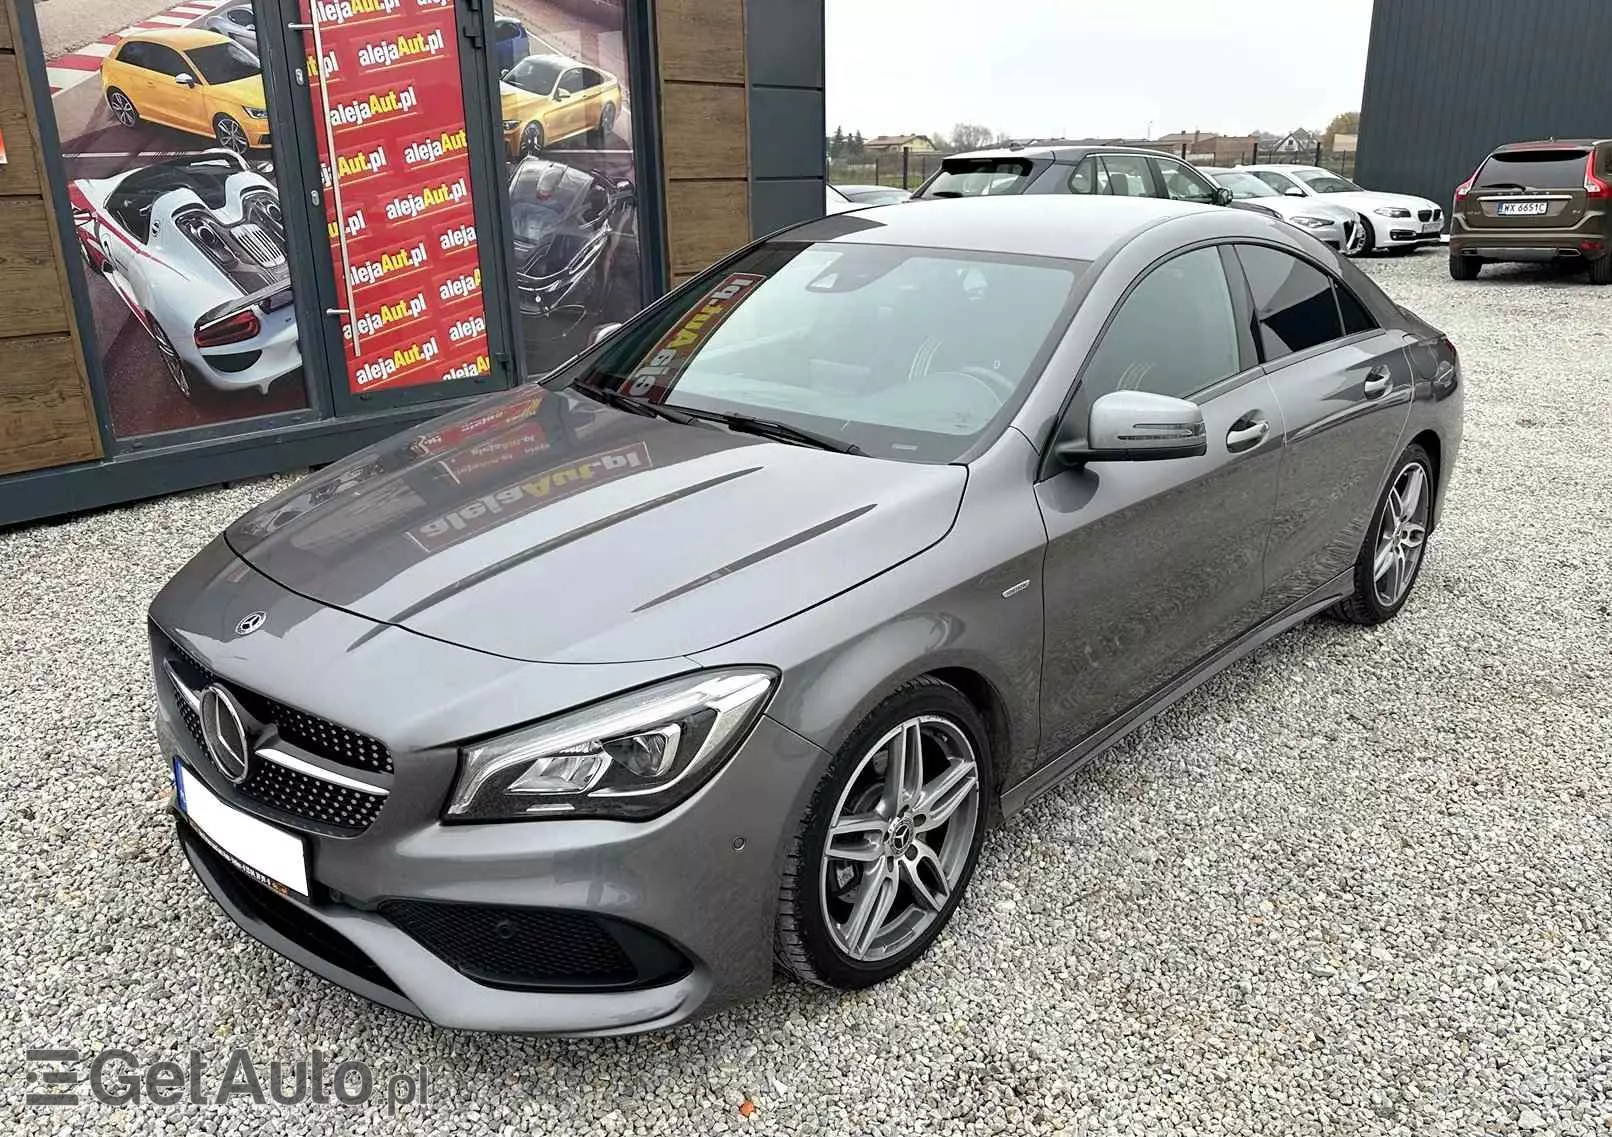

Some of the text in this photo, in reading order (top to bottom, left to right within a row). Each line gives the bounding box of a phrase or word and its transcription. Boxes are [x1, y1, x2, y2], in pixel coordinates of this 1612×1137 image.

[358, 29, 445, 66] alejaAut.pl
[329, 86, 417, 126] alejaAut.pl
[385, 177, 468, 219] alejaAut.pl
[439, 225, 476, 250] aleja
[342, 293, 426, 340] aejaAut.pl
[355, 336, 438, 385] alejaAut.pl
